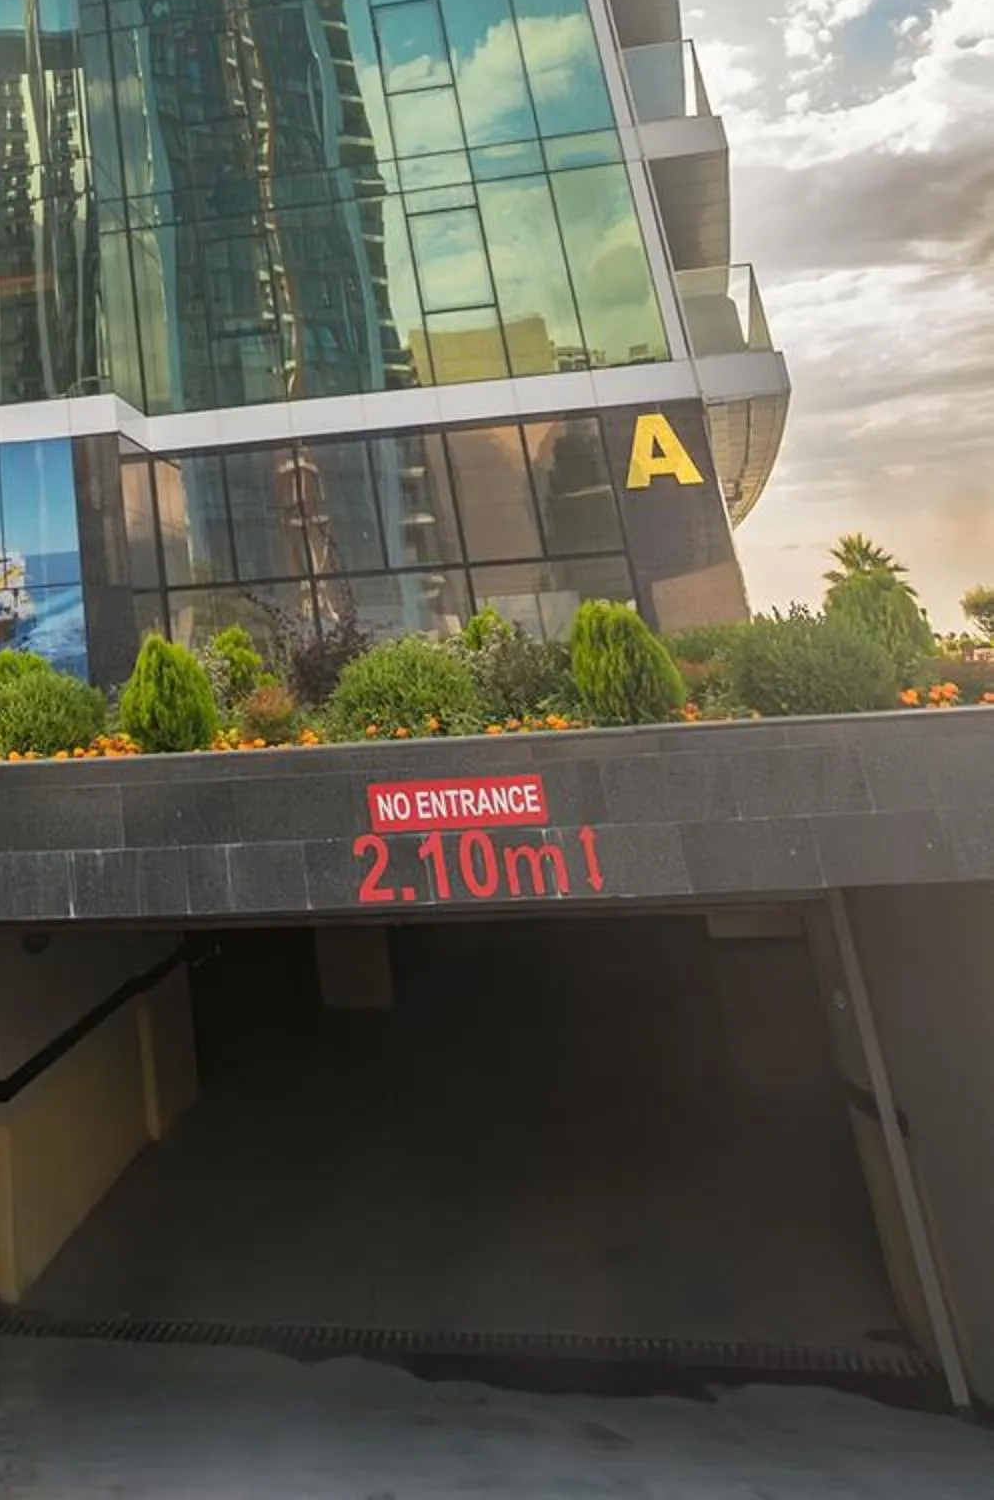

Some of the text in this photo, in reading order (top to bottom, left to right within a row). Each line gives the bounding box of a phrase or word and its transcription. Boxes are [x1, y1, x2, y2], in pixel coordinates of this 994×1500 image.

[626, 413, 705, 489] A
[376, 784, 541, 821] NO ENTRANCE
[352, 830, 570, 902] 2.10m
